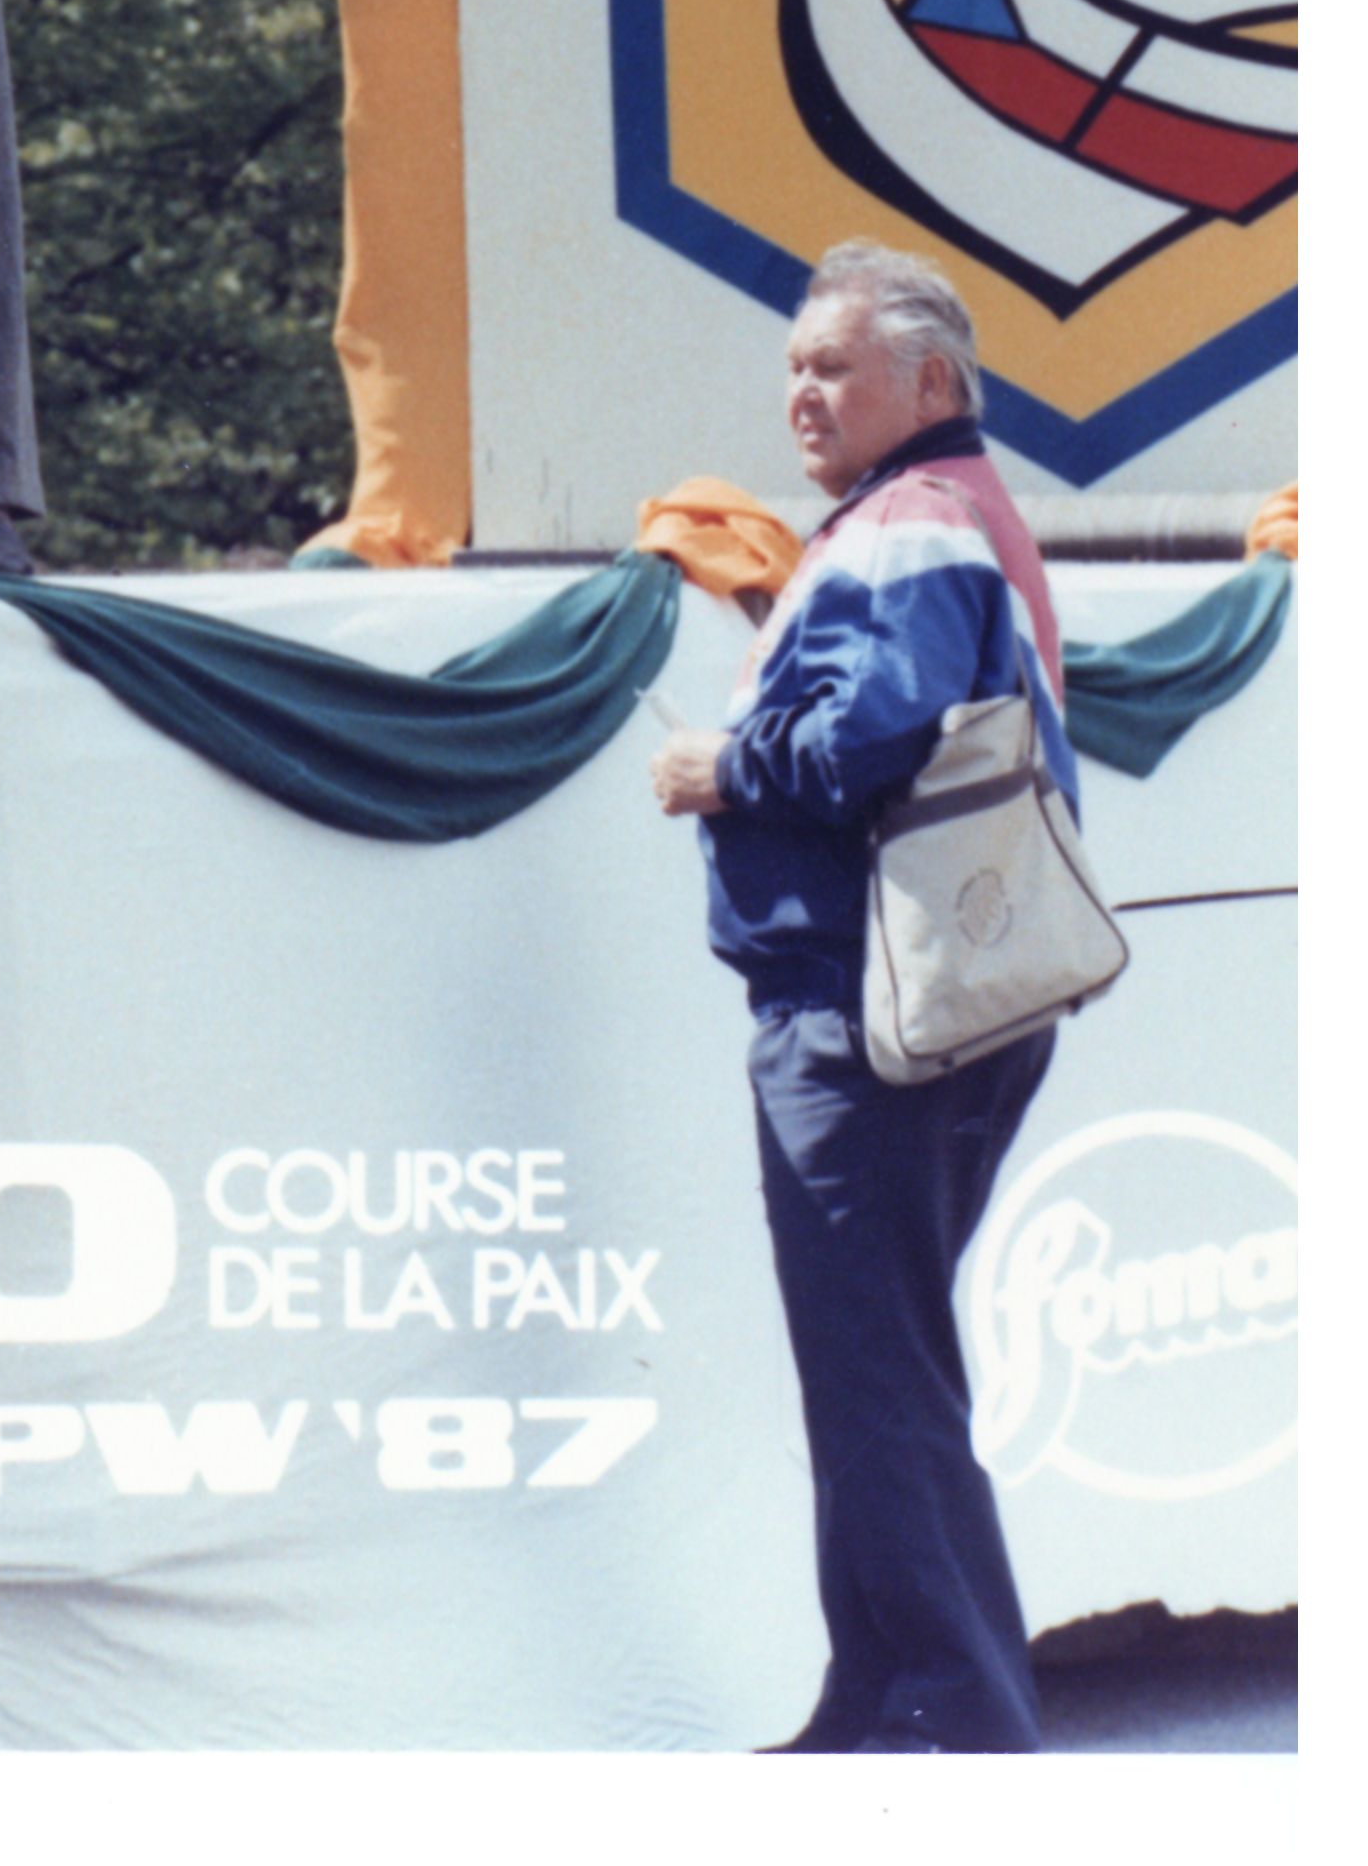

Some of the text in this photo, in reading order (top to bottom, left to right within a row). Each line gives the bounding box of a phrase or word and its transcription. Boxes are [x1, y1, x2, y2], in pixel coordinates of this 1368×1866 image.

[205, 1150, 566, 1233] COURSE
[207, 1250, 664, 1331] DE LA PAIX
[334, 1397, 659, 1490] '87
